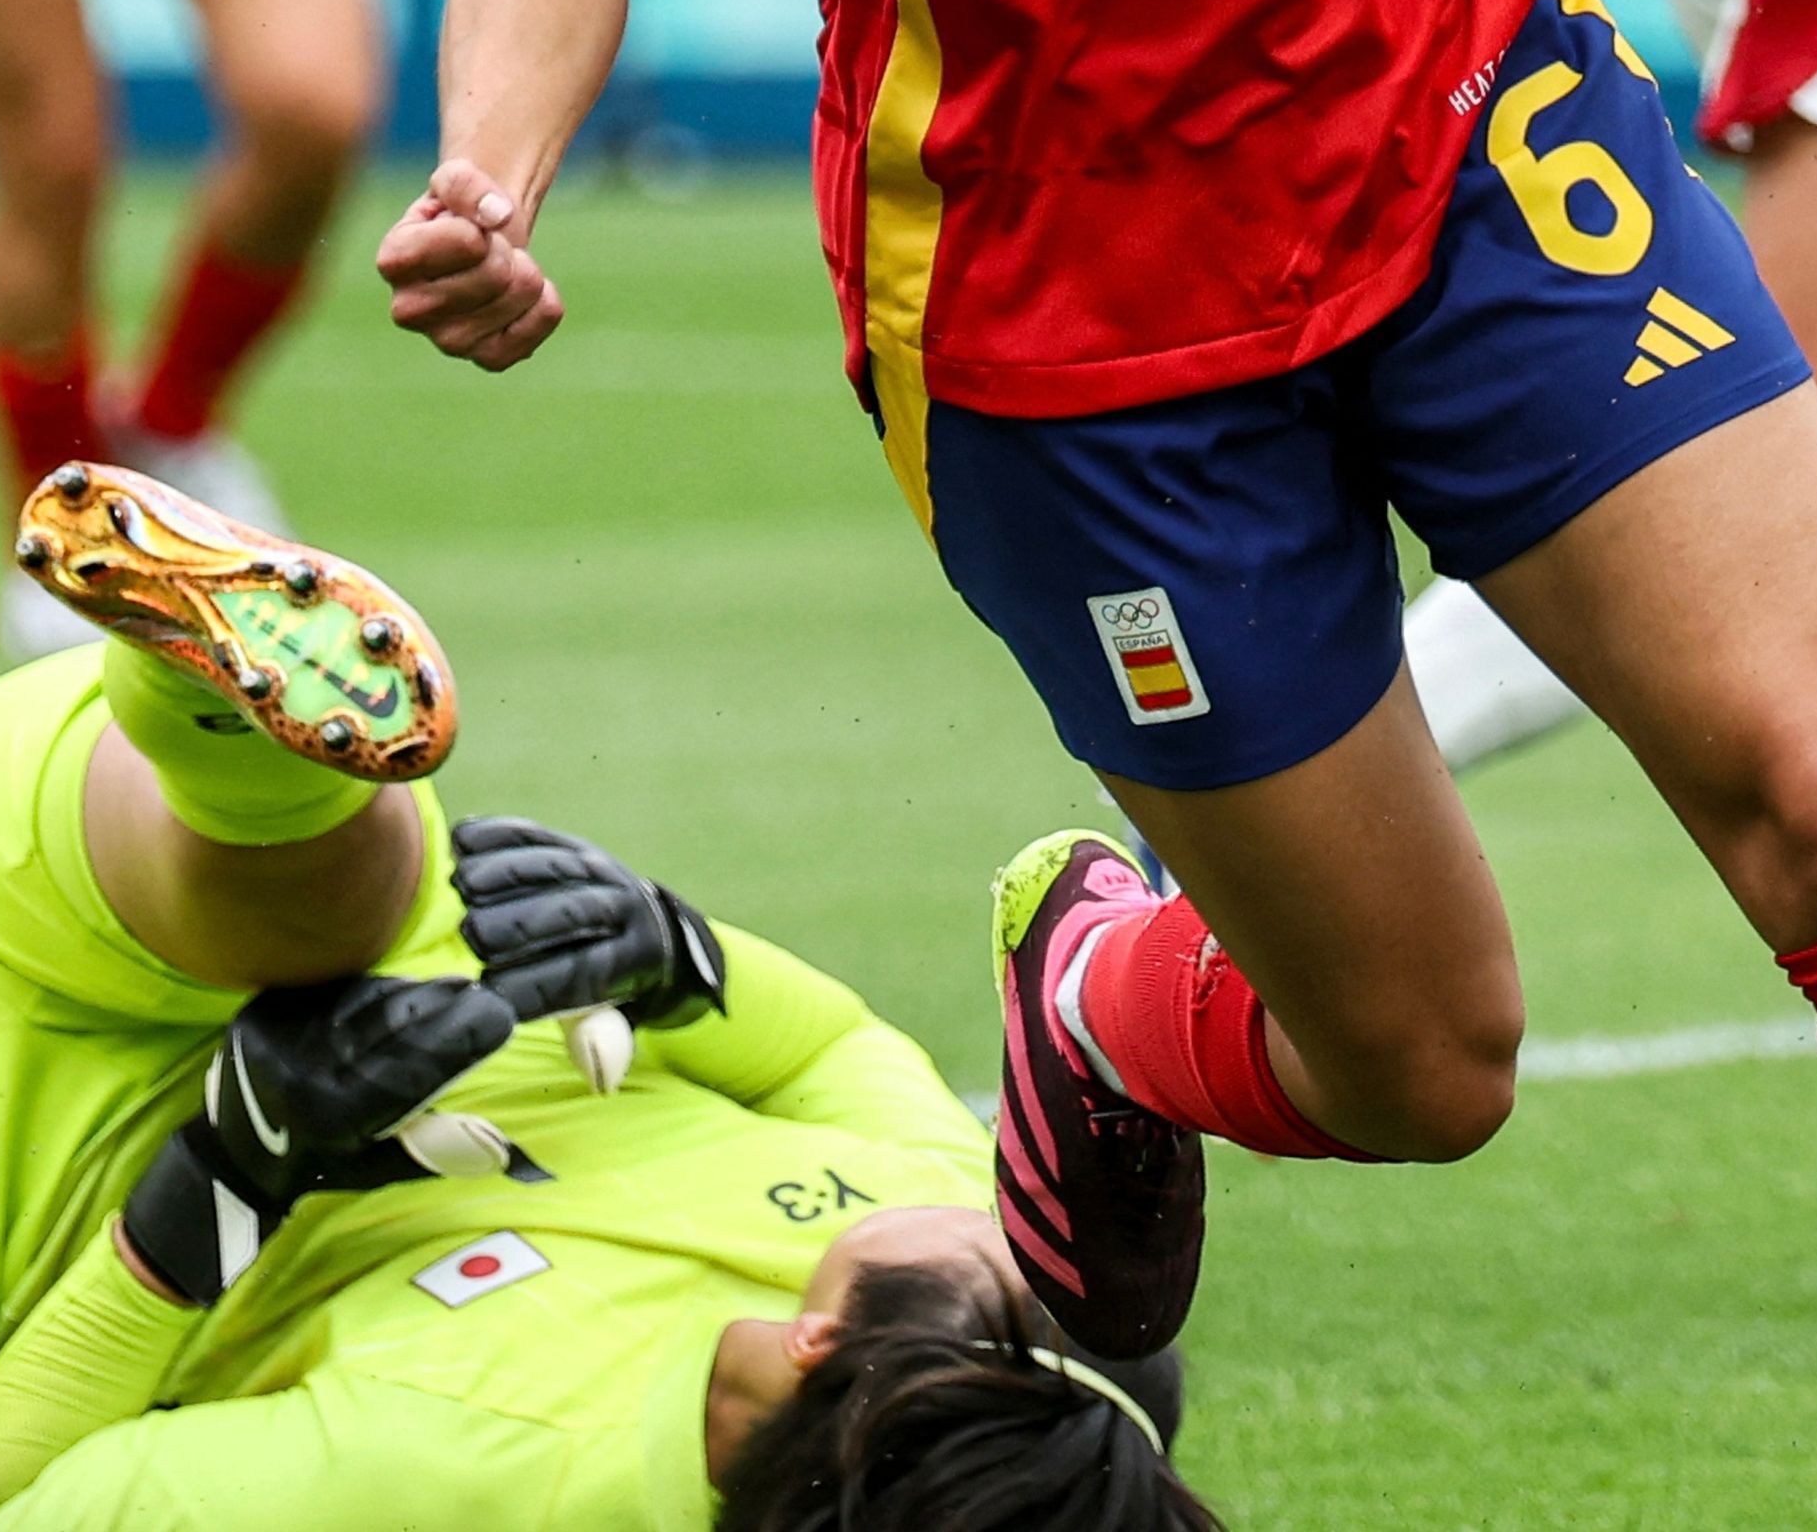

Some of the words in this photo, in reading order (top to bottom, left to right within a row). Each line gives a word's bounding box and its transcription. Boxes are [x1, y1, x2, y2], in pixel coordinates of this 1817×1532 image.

[1486, 61, 1654, 276] 6
[1119, 634, 1165, 650] ESPAÑA
[767, 1167, 877, 1222] Y-3
